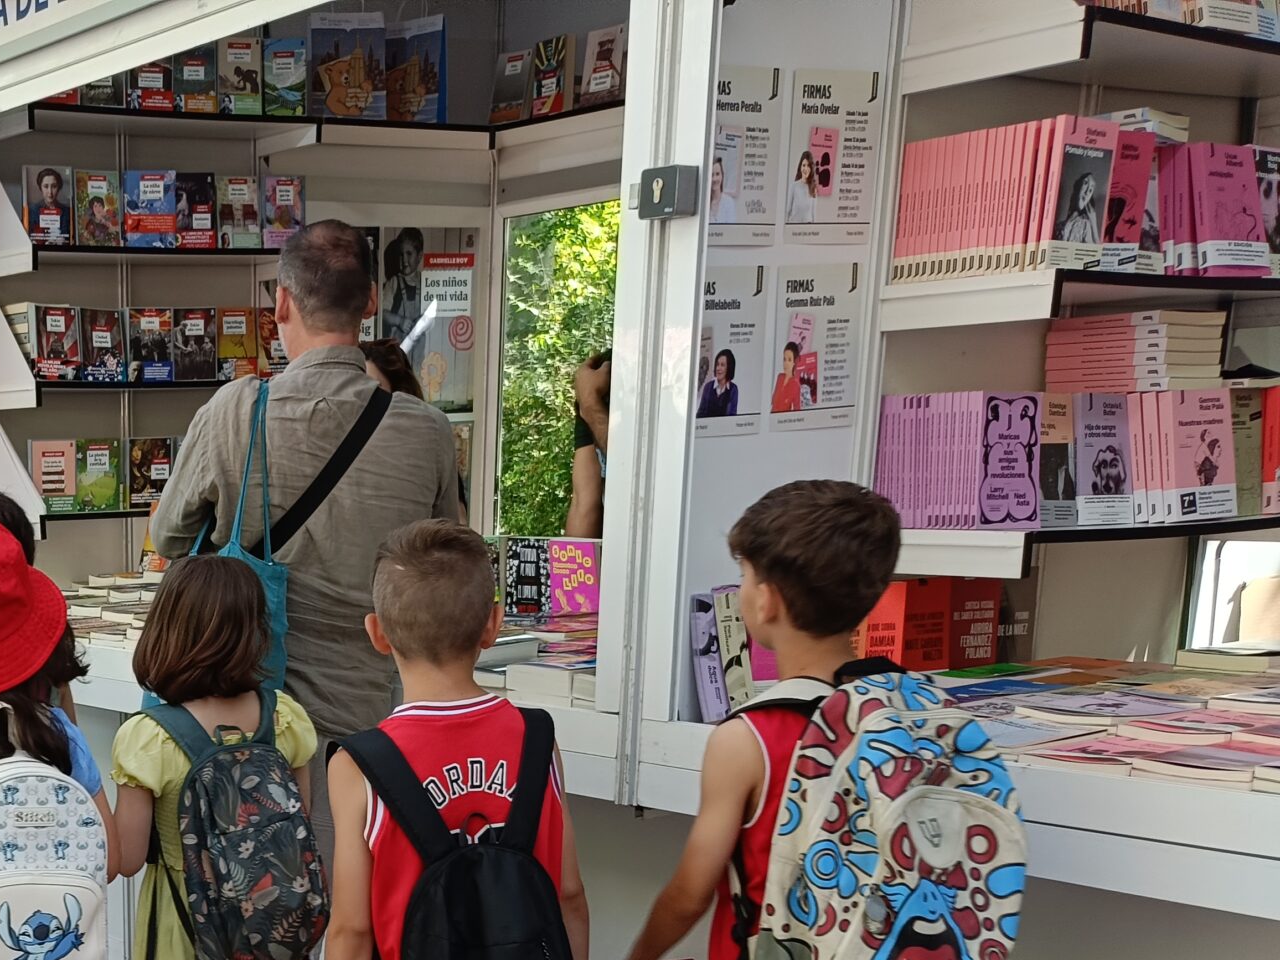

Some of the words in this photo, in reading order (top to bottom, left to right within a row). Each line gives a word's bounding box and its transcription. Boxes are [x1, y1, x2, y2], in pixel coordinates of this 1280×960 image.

[802, 85, 832, 100] FIRMAS
[716, 100, 740, 112] Herrera
[741, 100, 762, 113] Peralta
[801, 102, 819, 115] María
[820, 103, 839, 115] Ovelar
[424, 277, 441, 288] Los
[442, 276, 468, 288] niños
[786, 279, 815, 294] FIRMAS
[423, 291, 434, 302] de
[436, 292, 448, 301] mi
[449, 291, 468, 302] vida
[785, 297, 808, 308] Gemma
[809, 296, 821, 307] Ruiz
[1203, 418, 1224, 426] madres
[970, 622, 993, 634] AURORA
[1005, 624, 1013, 635] LA
[965, 647, 992, 659] POLANCO
[422, 758, 517, 809] ORDA
[14, 810, 56, 823] Stitch
